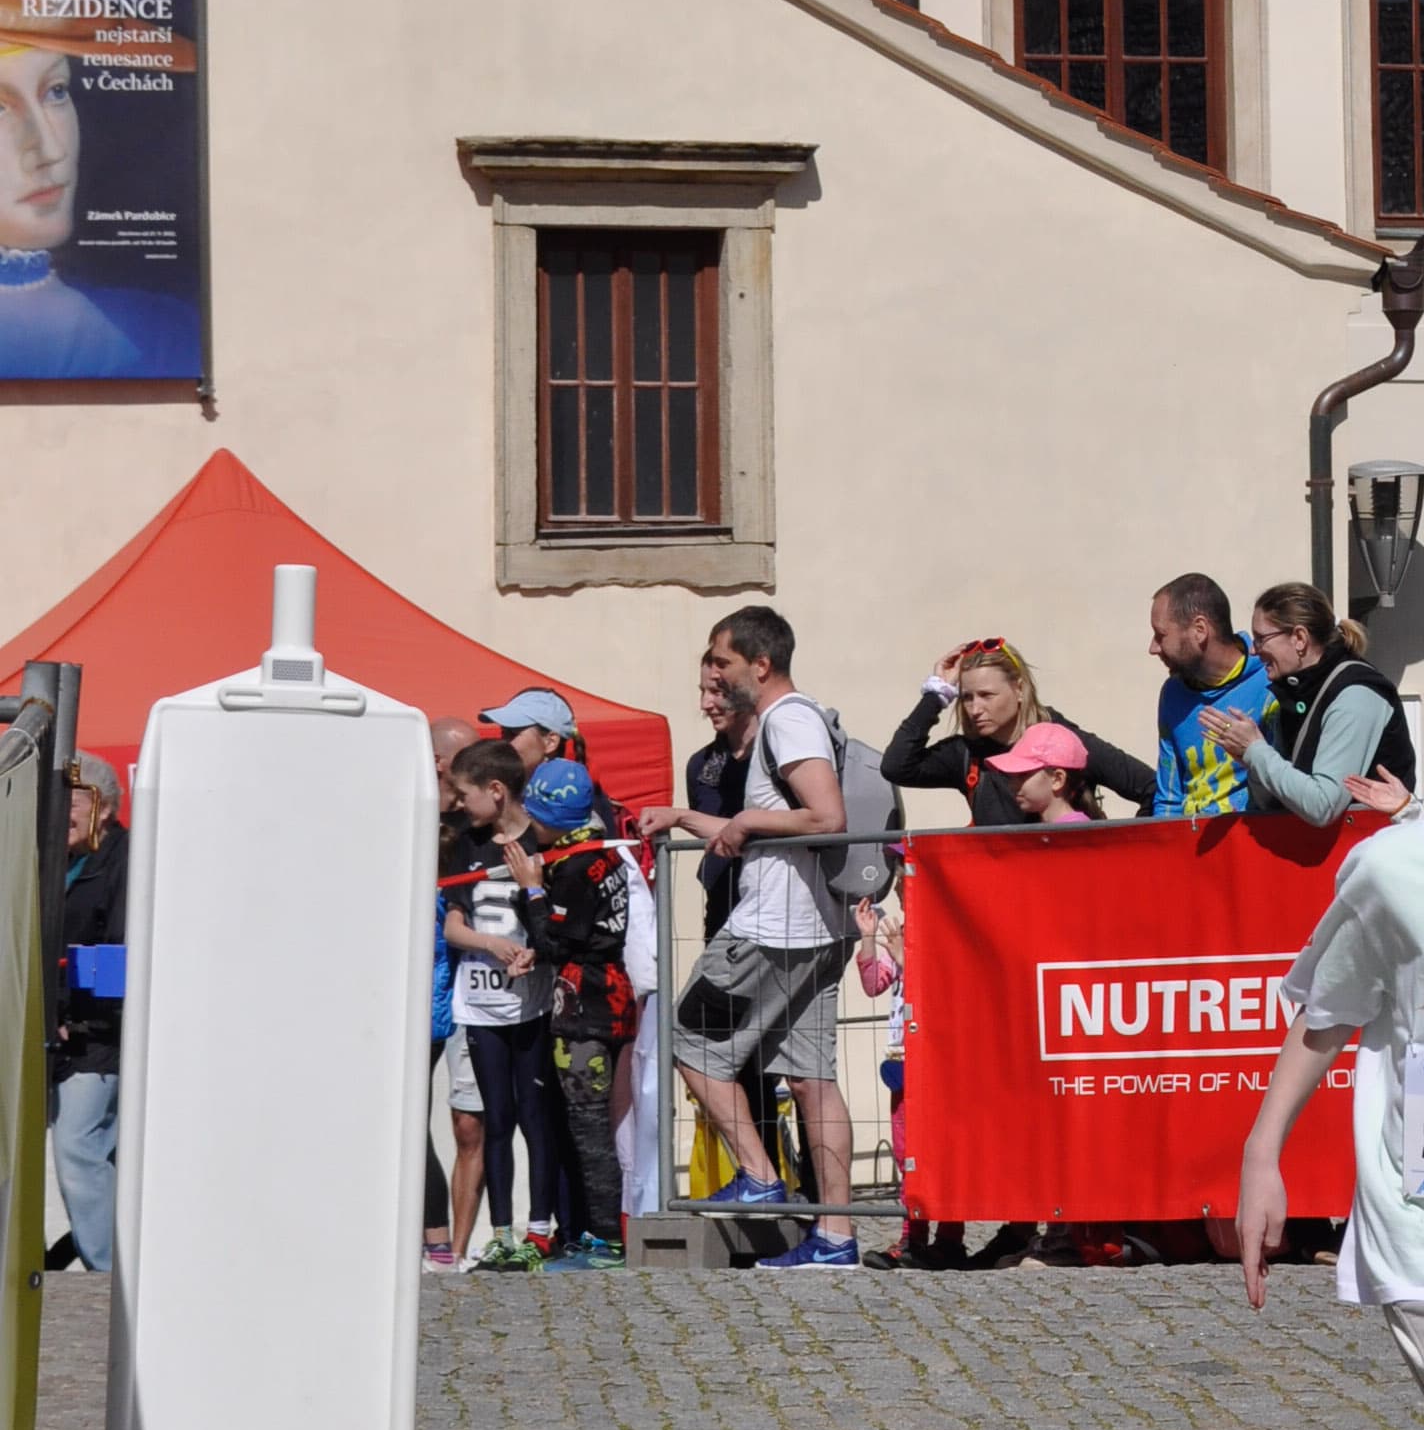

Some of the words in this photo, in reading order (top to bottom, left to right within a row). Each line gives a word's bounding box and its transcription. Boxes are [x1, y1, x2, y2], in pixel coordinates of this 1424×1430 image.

[95, 26, 173, 45] nejstarší
[82, 54, 174, 67] renesance
[82, 77, 94, 90] v
[97, 71, 174, 91] Čechách
[1060, 976, 1303, 1036] NUTREN
[1049, 1076, 1095, 1096] THE
[1104, 1073, 1191, 1095] POWER
[1200, 1072, 1231, 1092] OF
